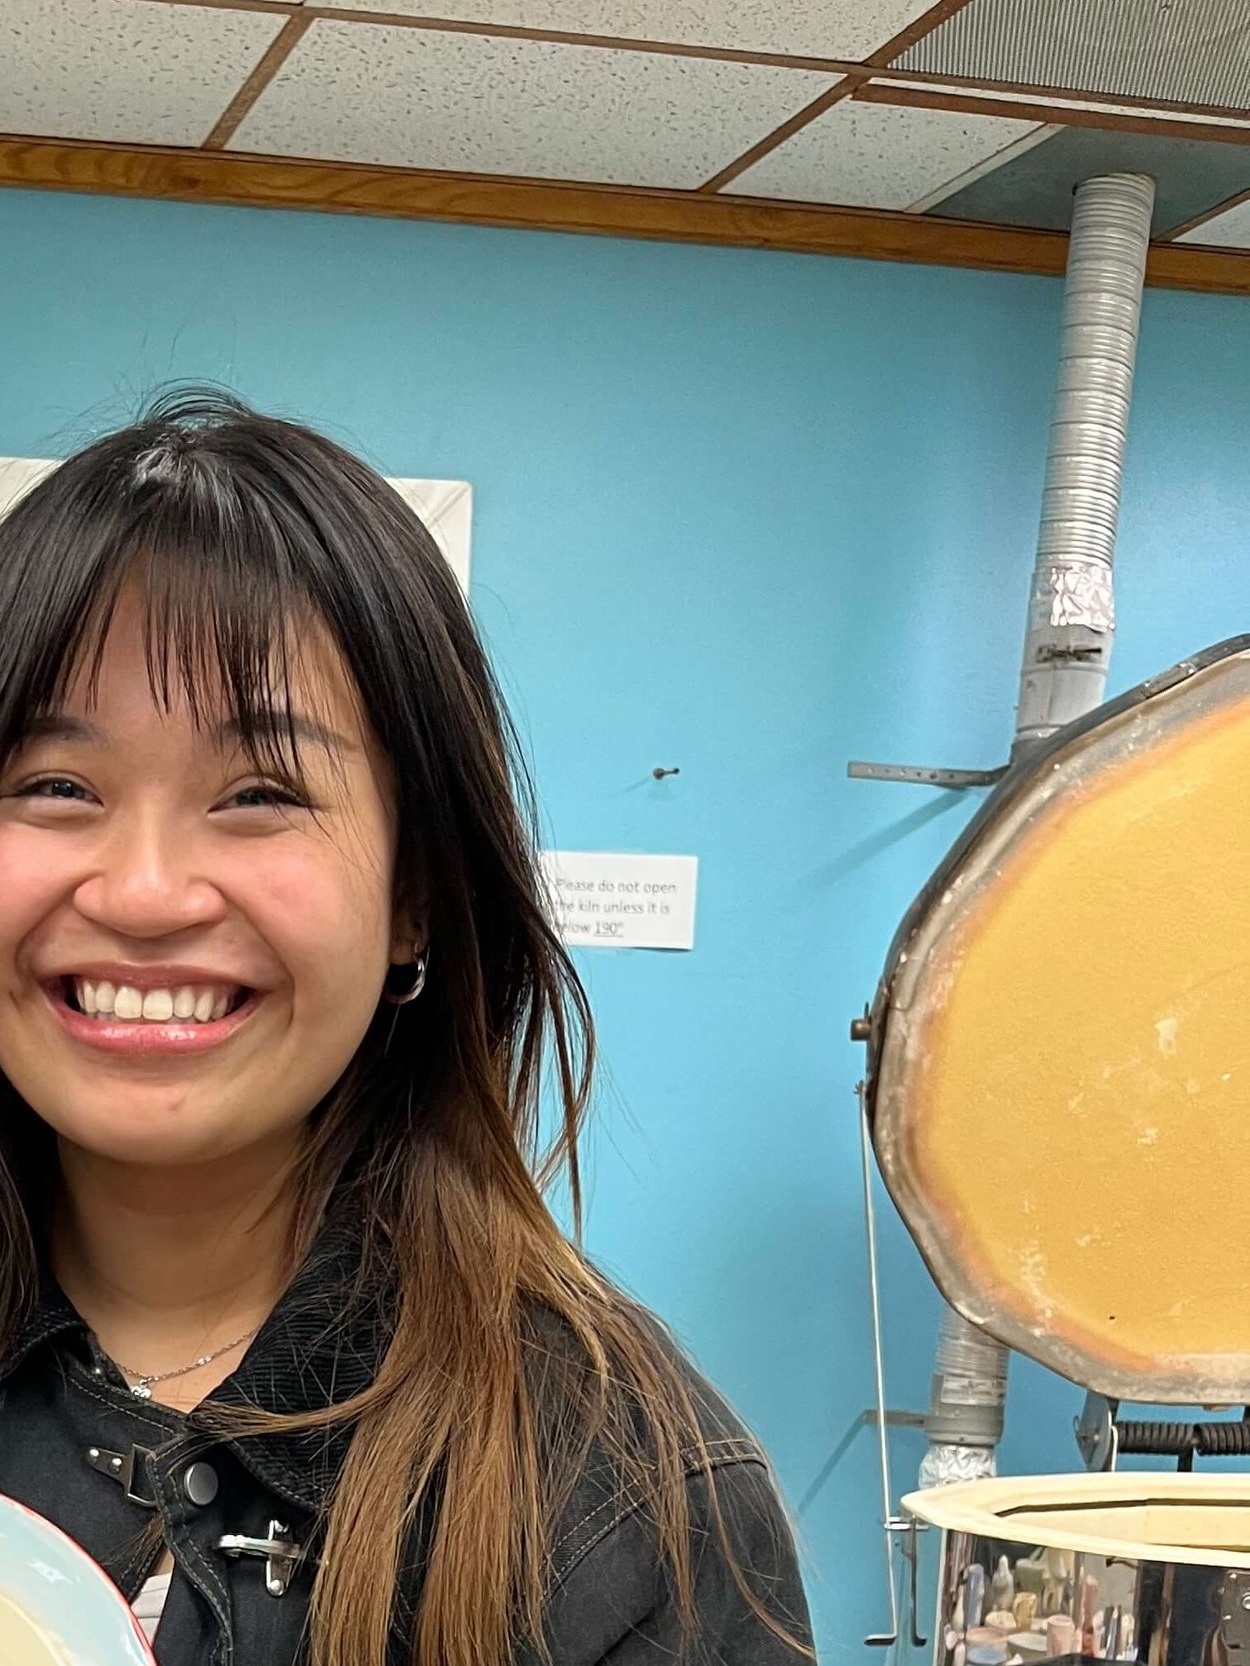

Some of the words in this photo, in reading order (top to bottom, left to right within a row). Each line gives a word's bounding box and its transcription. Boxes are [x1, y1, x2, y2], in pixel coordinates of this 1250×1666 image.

[556, 878, 595, 892] Please
[598, 878, 615, 892] do
[618, 879, 640, 893] not
[643, 881, 677, 896] open
[578, 899, 600, 912] kiln
[603, 900, 644, 914] unless
[647, 901, 658, 914] it
[660, 901, 671, 914] is
